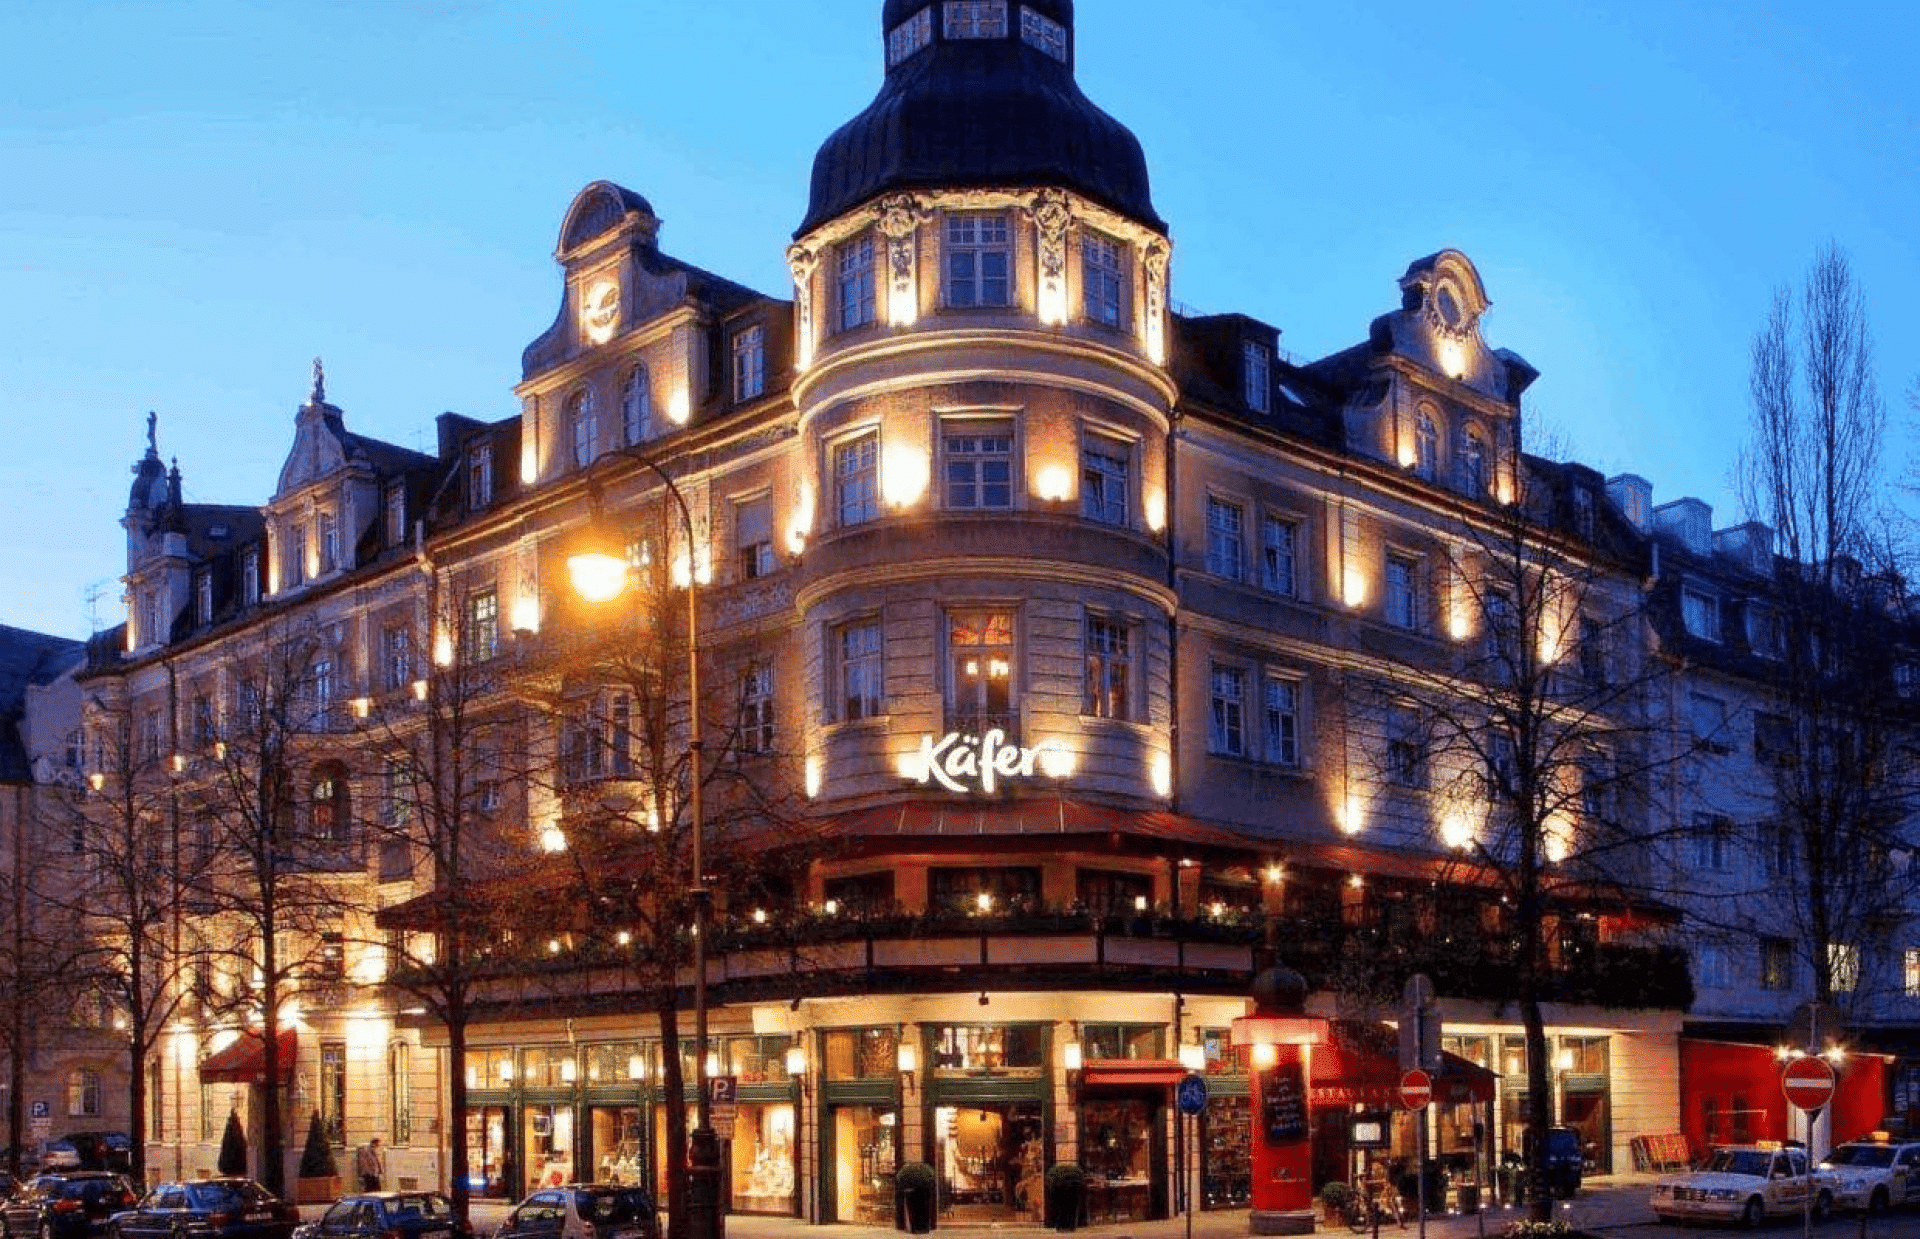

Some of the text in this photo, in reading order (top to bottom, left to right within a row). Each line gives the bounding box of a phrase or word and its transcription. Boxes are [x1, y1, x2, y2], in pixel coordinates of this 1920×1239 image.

[918, 729, 1052, 793] Käfer
[713, 1080, 729, 1099] P
[34, 1102, 45, 1115] P
